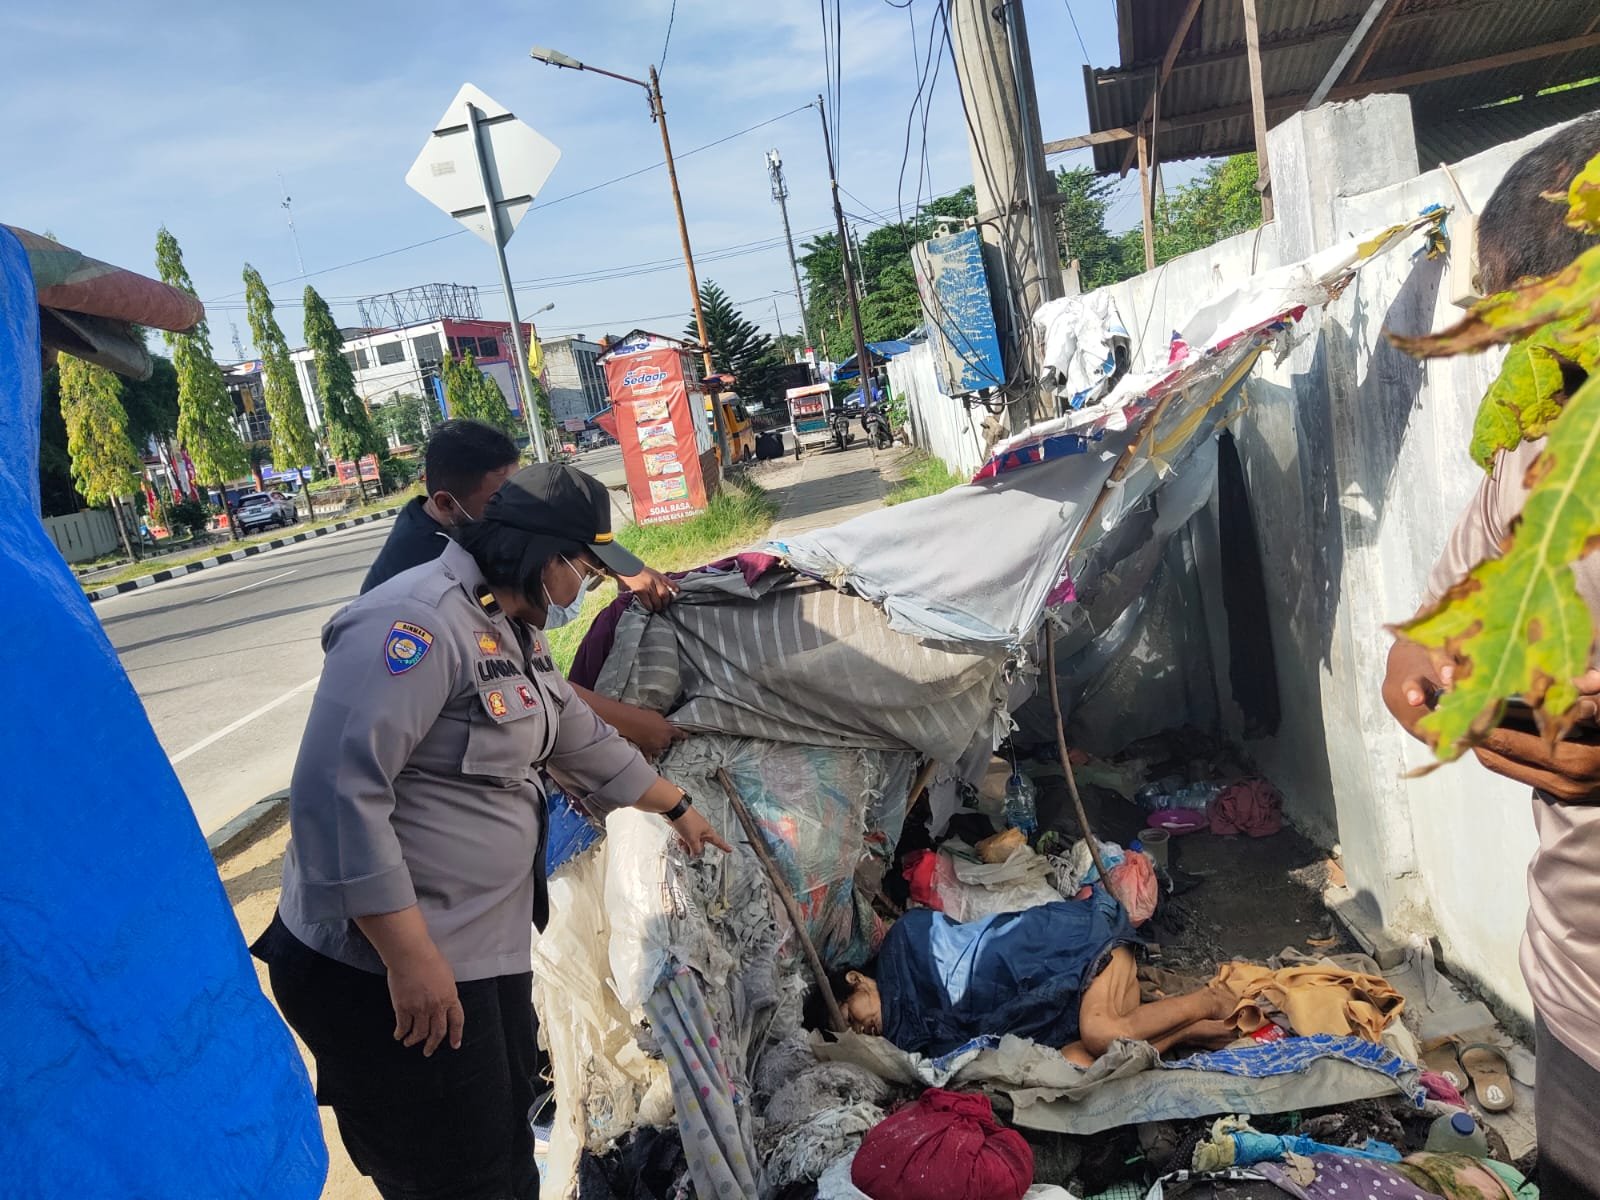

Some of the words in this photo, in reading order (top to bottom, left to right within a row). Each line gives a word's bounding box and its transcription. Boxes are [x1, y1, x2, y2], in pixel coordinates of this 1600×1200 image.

[624, 372, 667, 386] Sedaap
[650, 505, 670, 515] SOAL
[478, 659, 522, 681] LINDA
